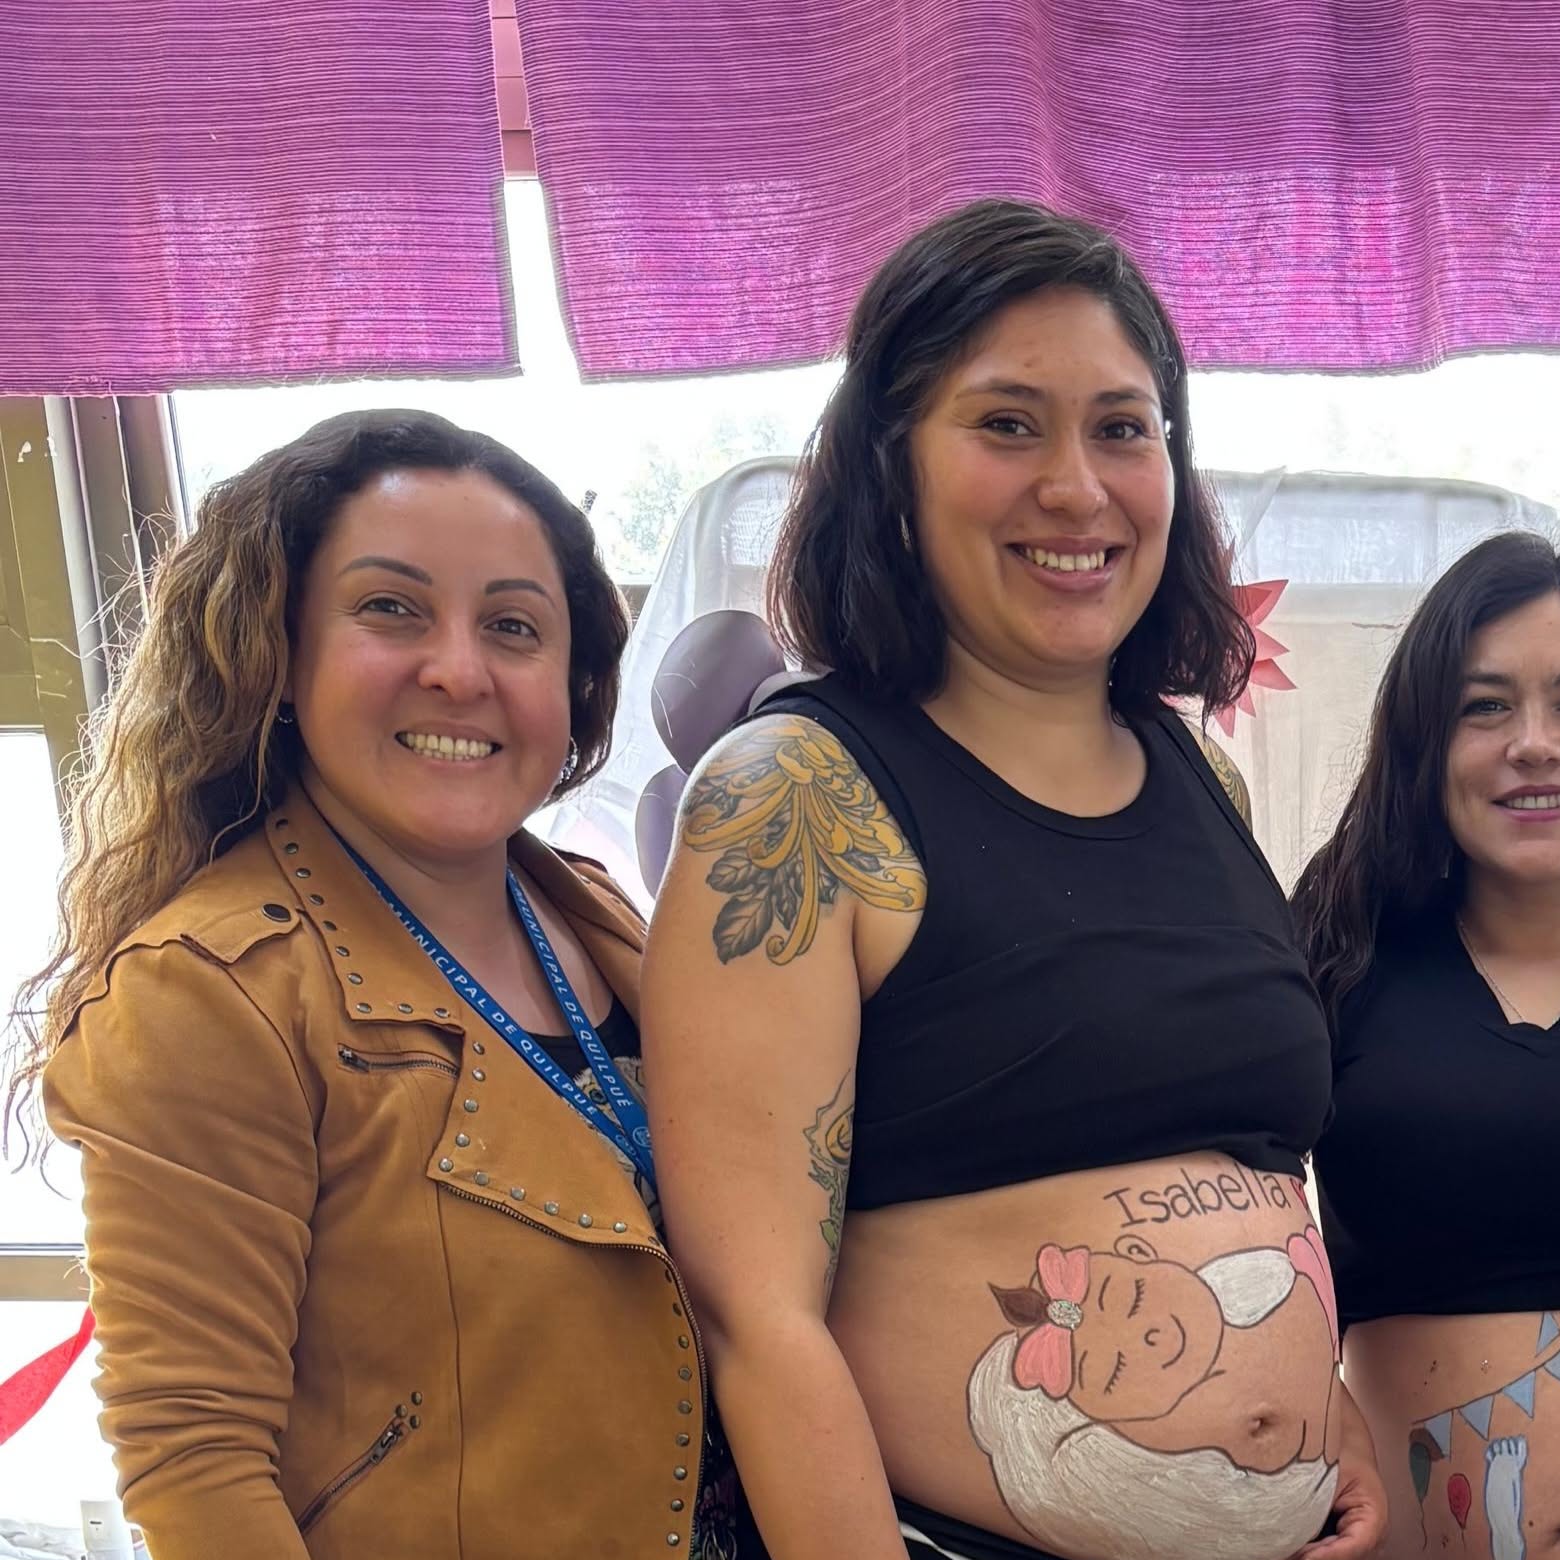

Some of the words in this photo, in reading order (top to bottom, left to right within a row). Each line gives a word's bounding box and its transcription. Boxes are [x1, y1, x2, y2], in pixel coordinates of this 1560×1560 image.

[491, 1011, 518, 1035] DE
[564, 1000, 585, 1025] DE
[1103, 1162, 1292, 1229] Isabella
